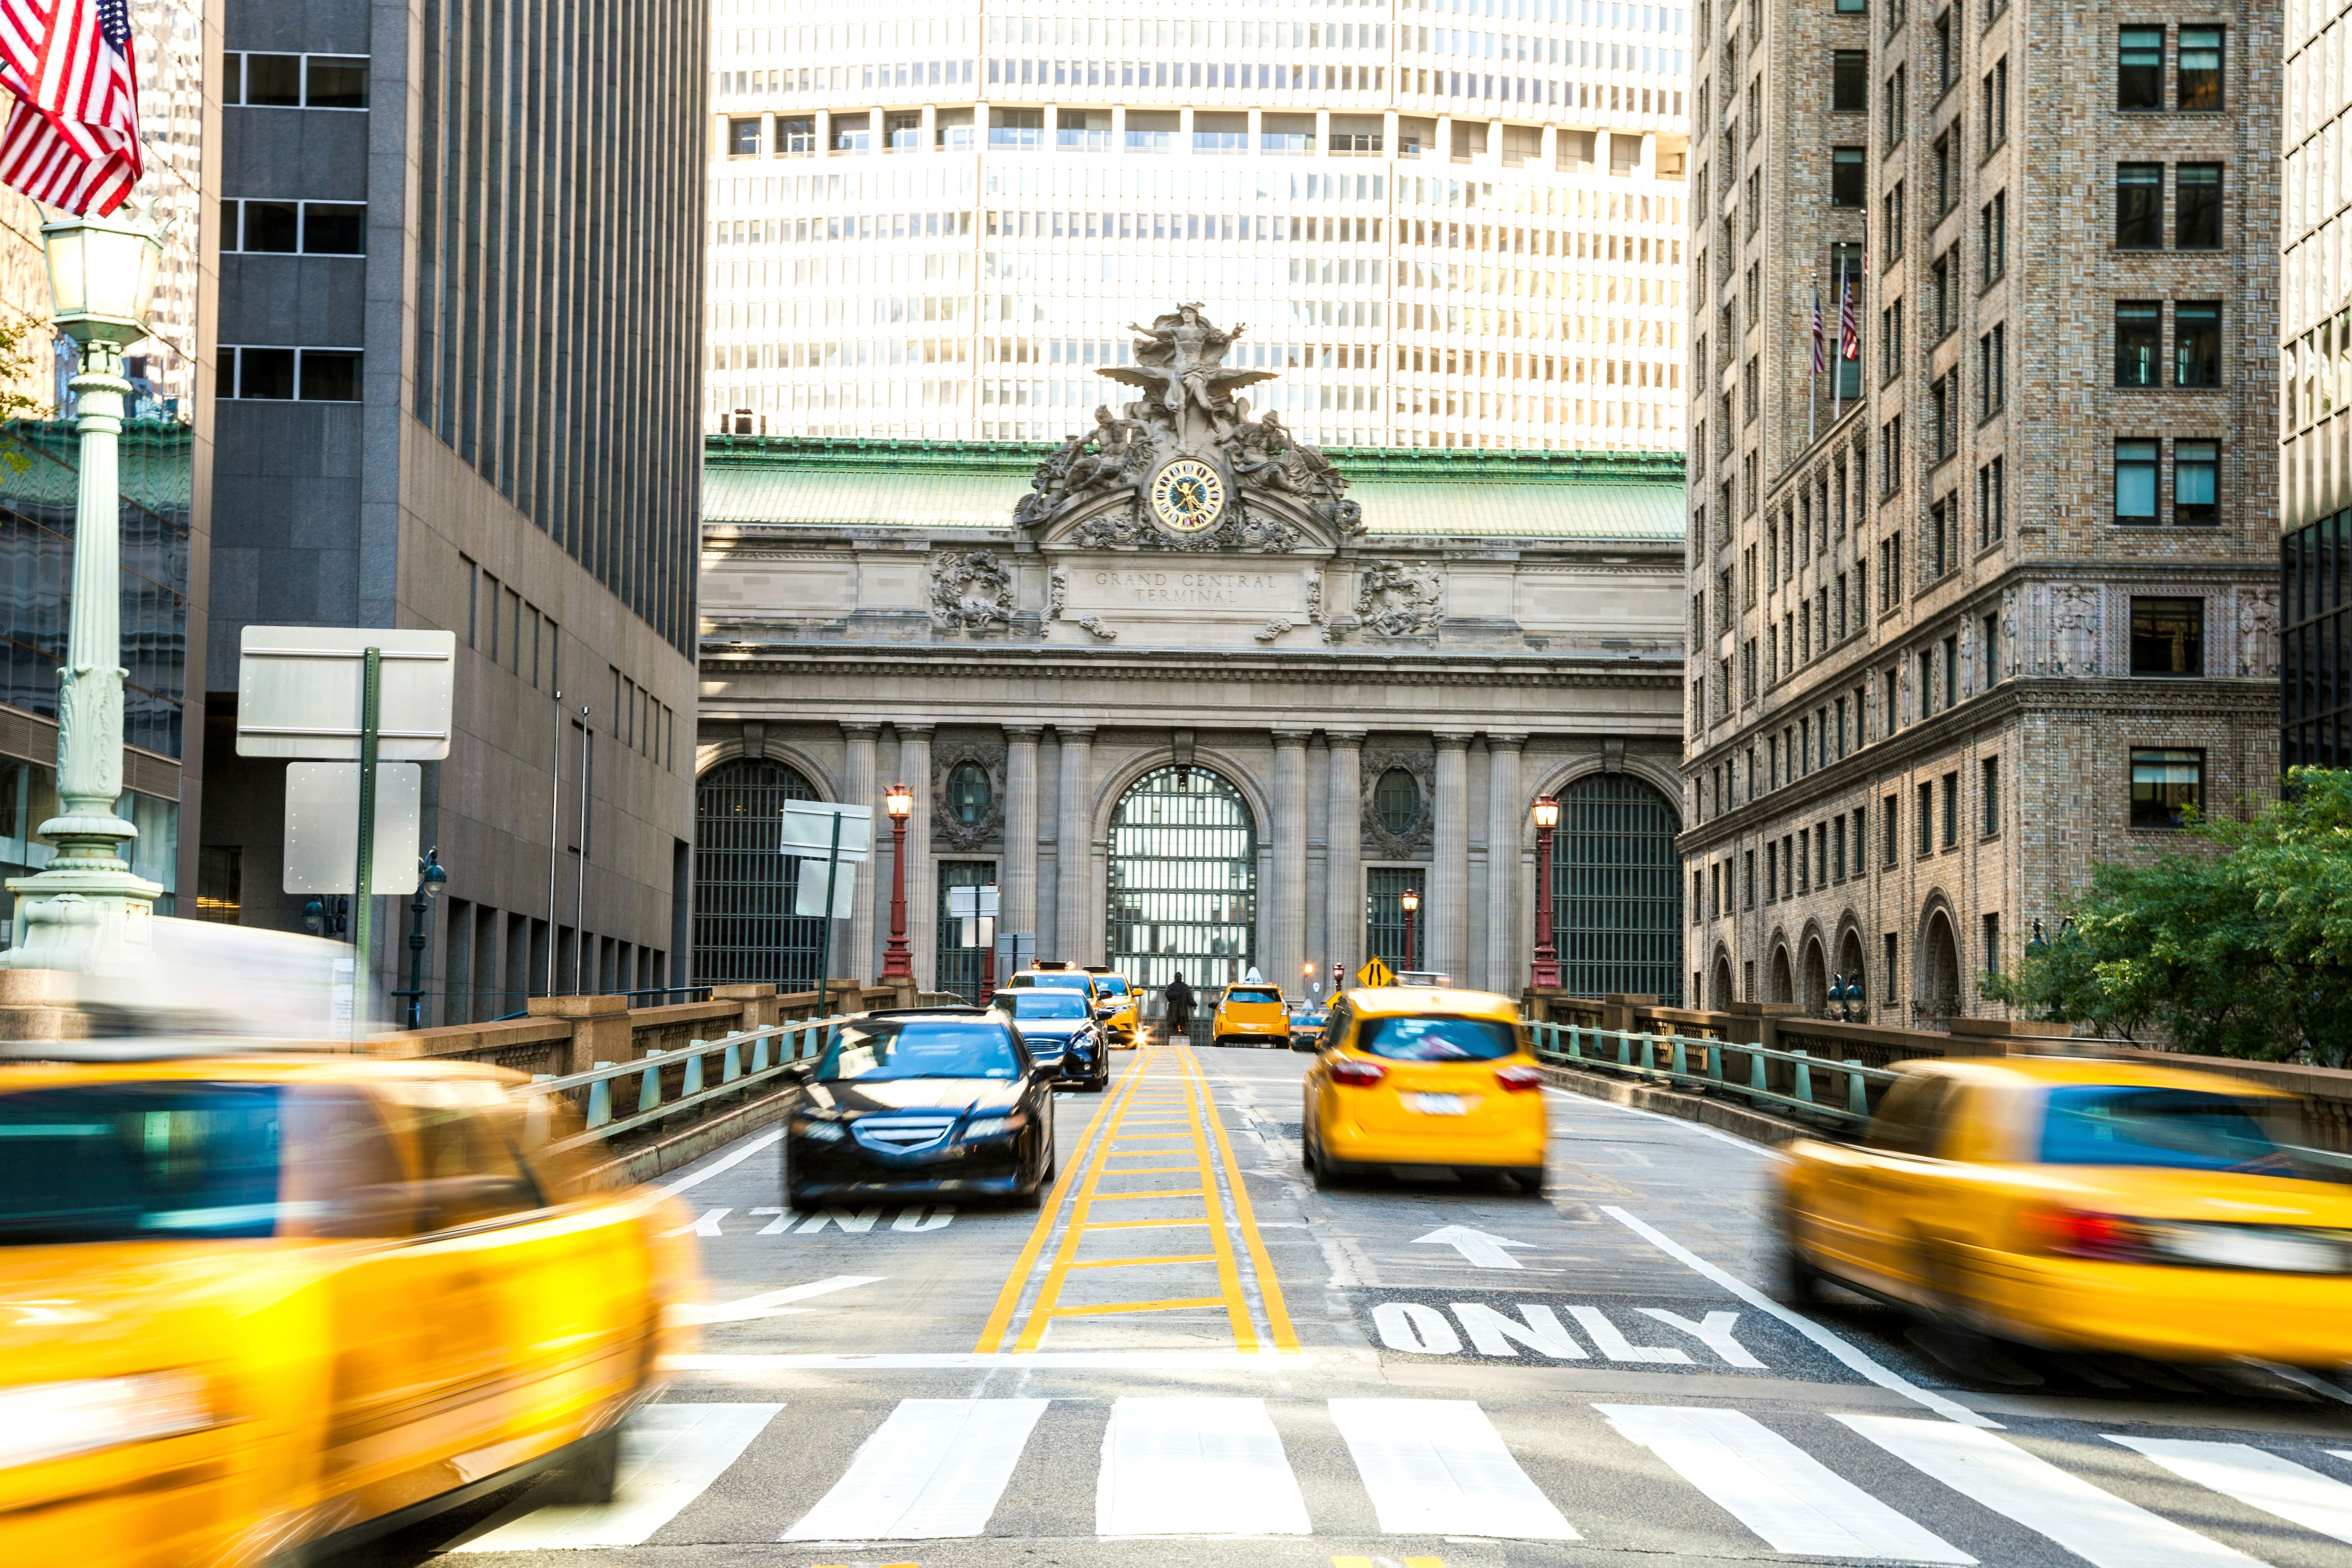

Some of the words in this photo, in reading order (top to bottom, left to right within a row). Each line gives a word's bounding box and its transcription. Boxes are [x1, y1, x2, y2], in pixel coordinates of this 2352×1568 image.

[1096, 573, 1167, 586] GRAND
[1182, 574, 1276, 588] CENTRAL
[1135, 589, 1237, 603] TERMINAL
[1371, 1302, 1770, 1369] ONLY
